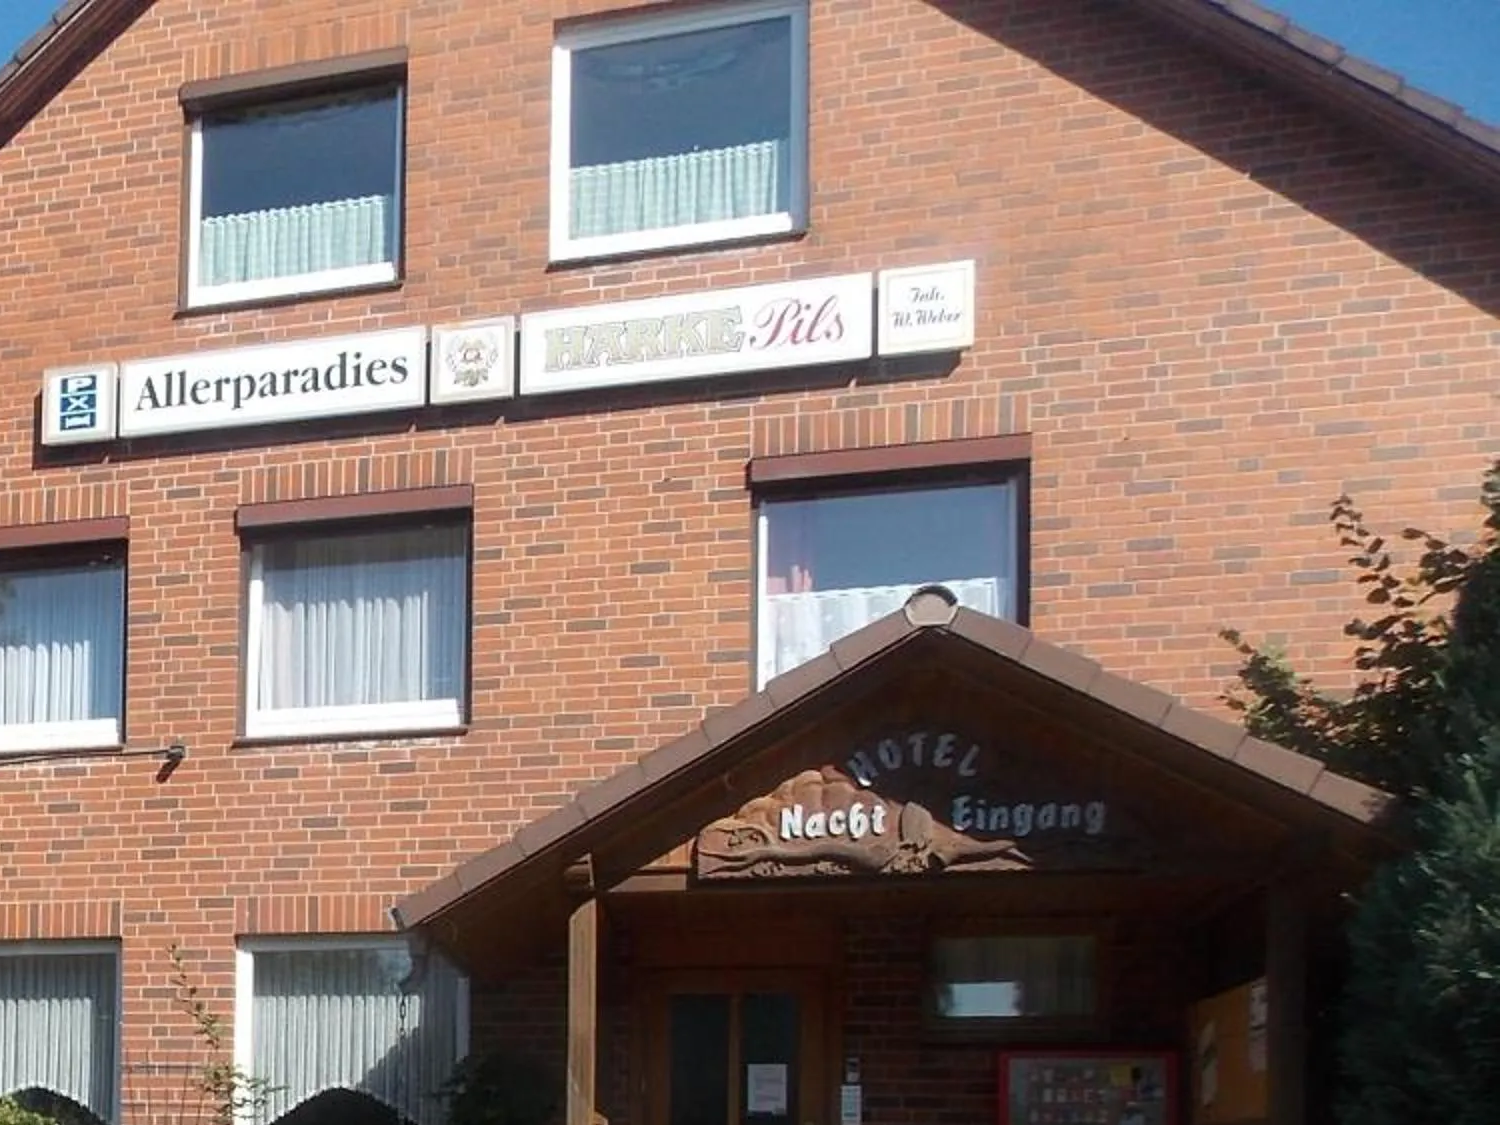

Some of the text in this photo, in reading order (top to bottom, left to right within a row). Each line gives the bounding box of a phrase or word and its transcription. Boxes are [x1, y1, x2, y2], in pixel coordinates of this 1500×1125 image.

[749, 295, 845, 350] Pils
[135, 351, 409, 410] Allerparadies
[847, 733, 979, 787] HOTEL
[952, 796, 1107, 836] Eingang
